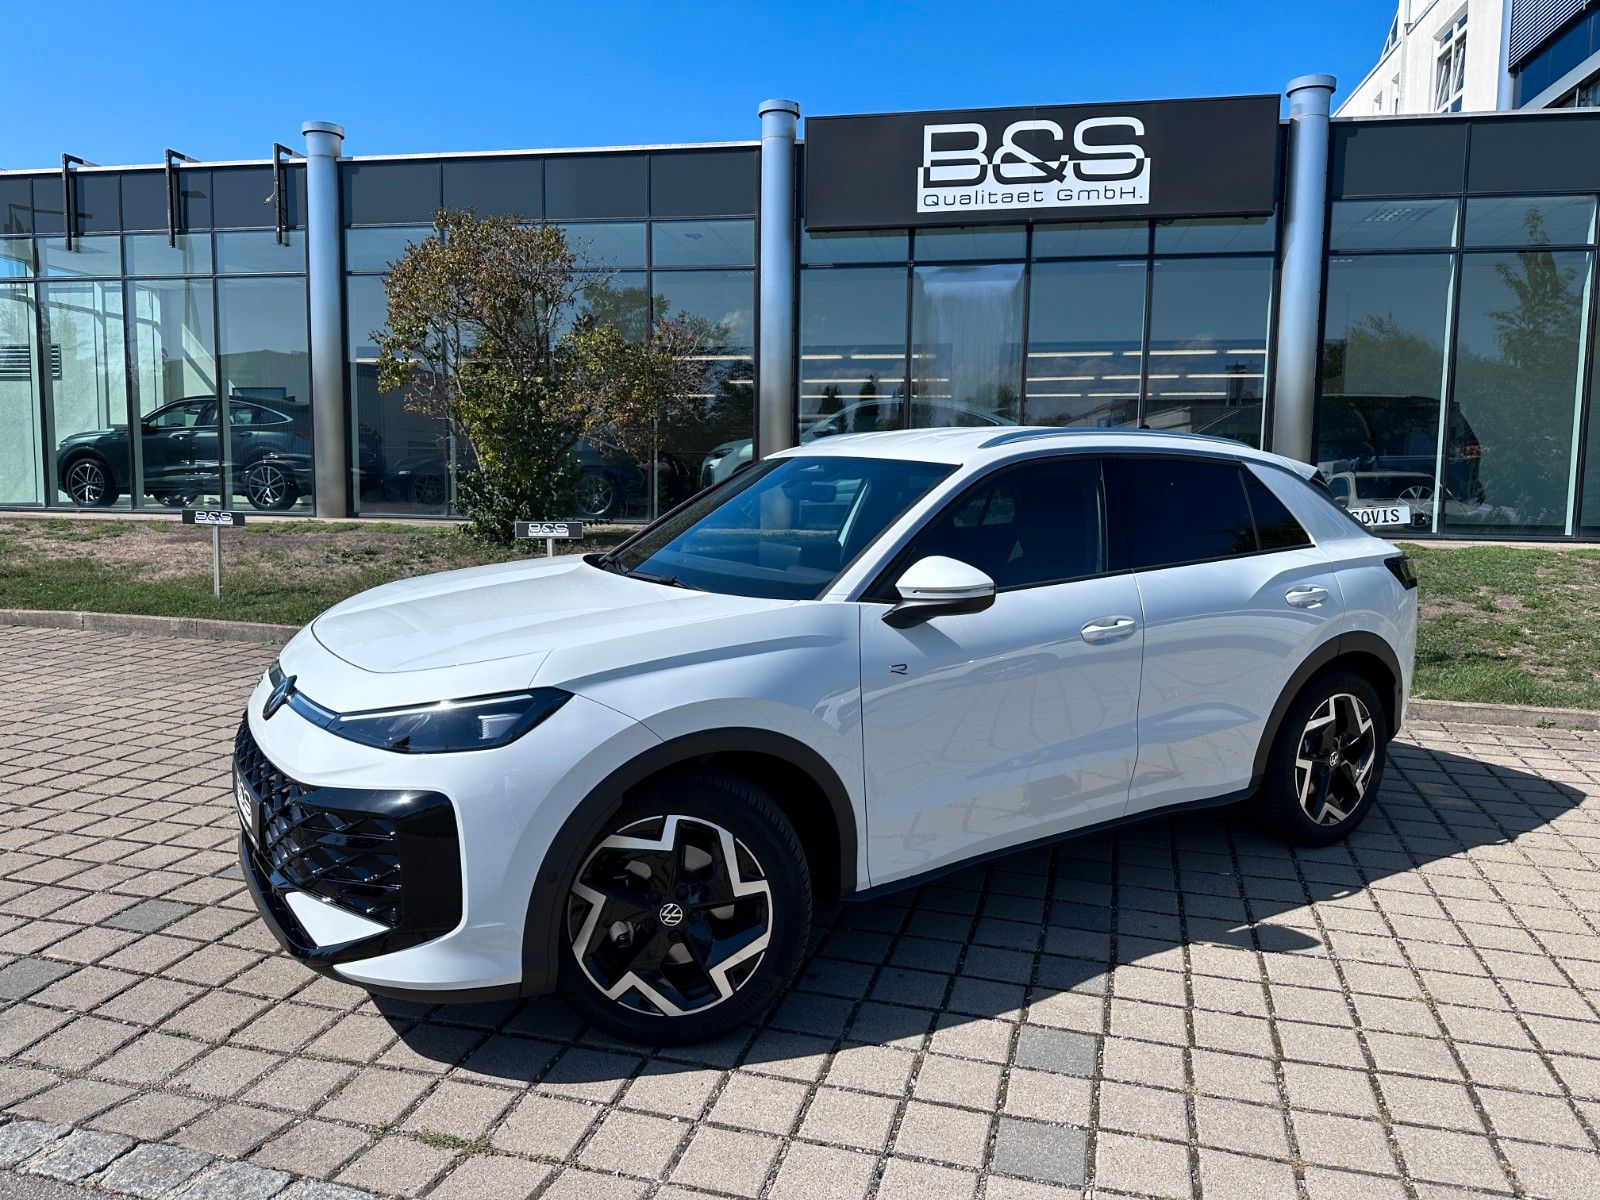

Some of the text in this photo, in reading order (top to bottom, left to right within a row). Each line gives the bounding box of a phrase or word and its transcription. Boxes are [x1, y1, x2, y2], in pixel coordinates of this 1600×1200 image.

[923, 116, 1145, 188] B&S
[923, 185, 1143, 207] Qualitaet GmbH.
[195, 511, 233, 521] B&S
[528, 523, 568, 534] B&S
